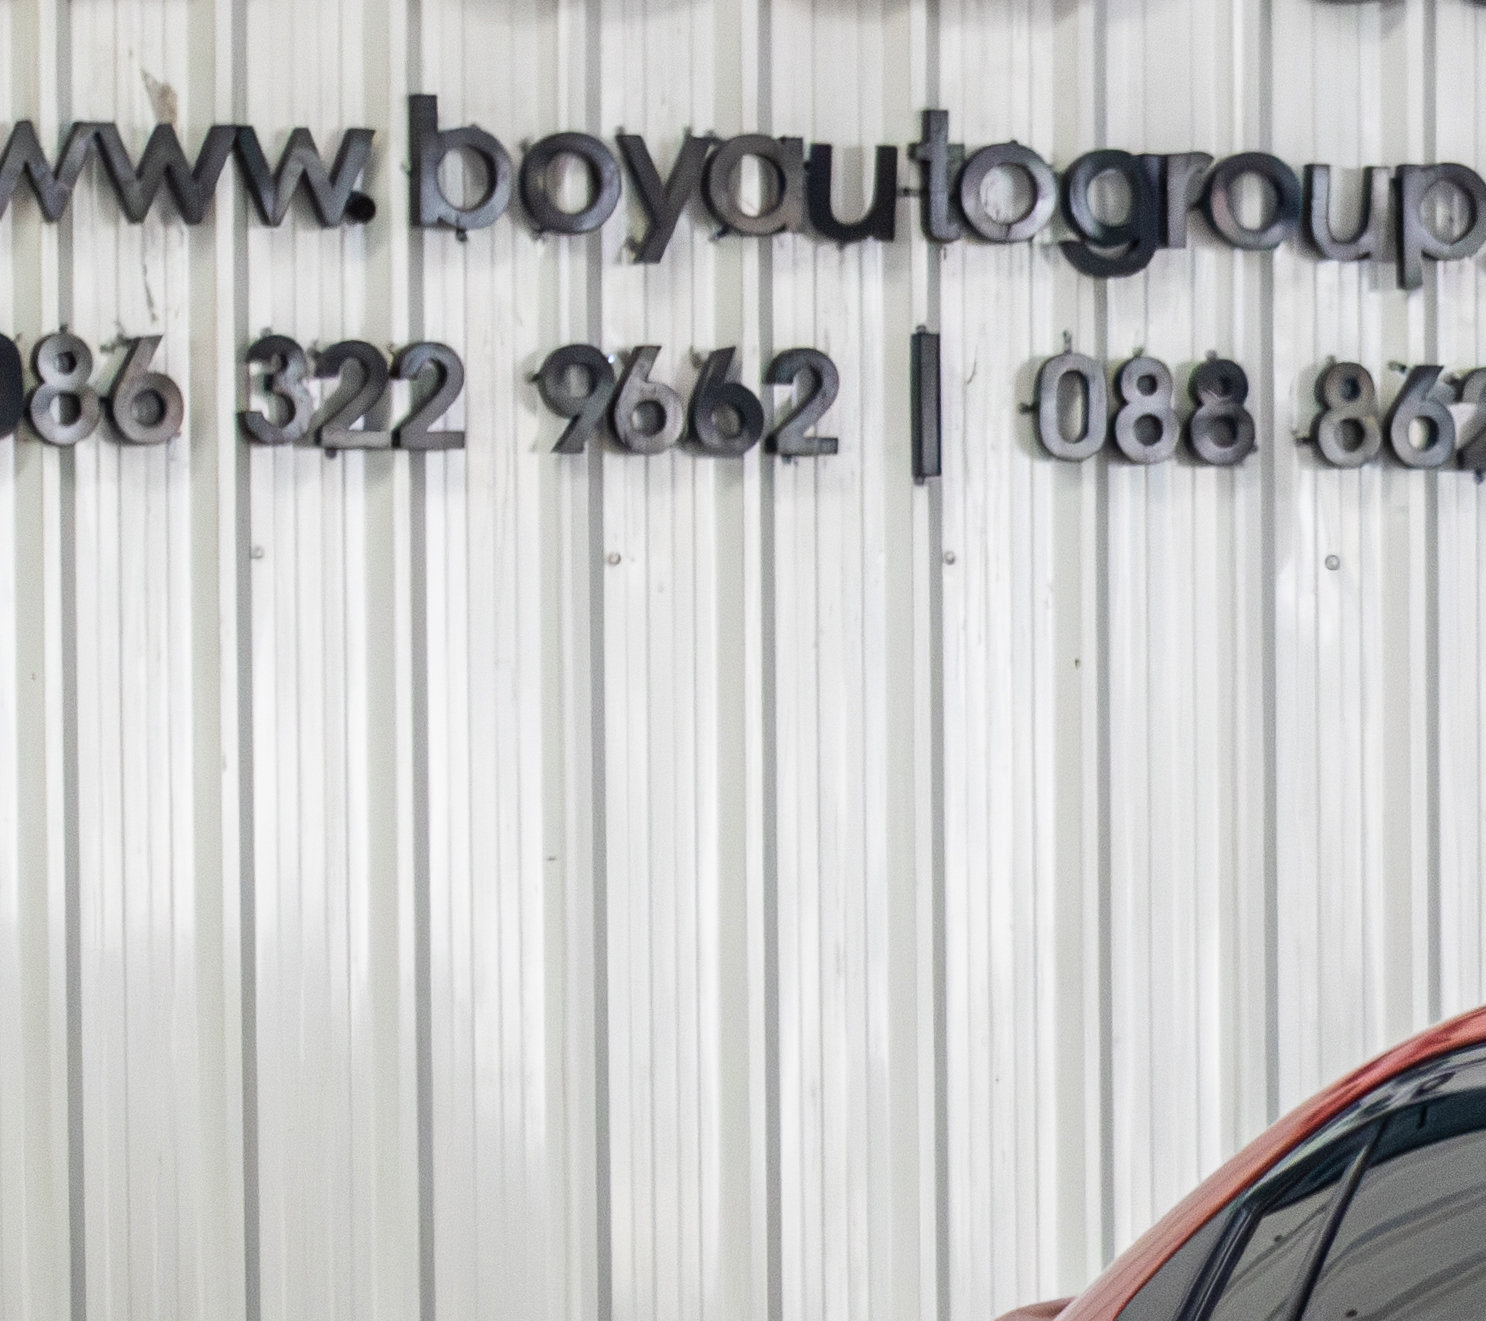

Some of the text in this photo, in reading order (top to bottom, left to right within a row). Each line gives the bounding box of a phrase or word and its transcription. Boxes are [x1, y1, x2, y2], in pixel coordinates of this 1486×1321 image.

[236, 335, 465, 449] 322
[537, 343, 839, 456] 9662
[1036, 351, 1256, 466] 088
